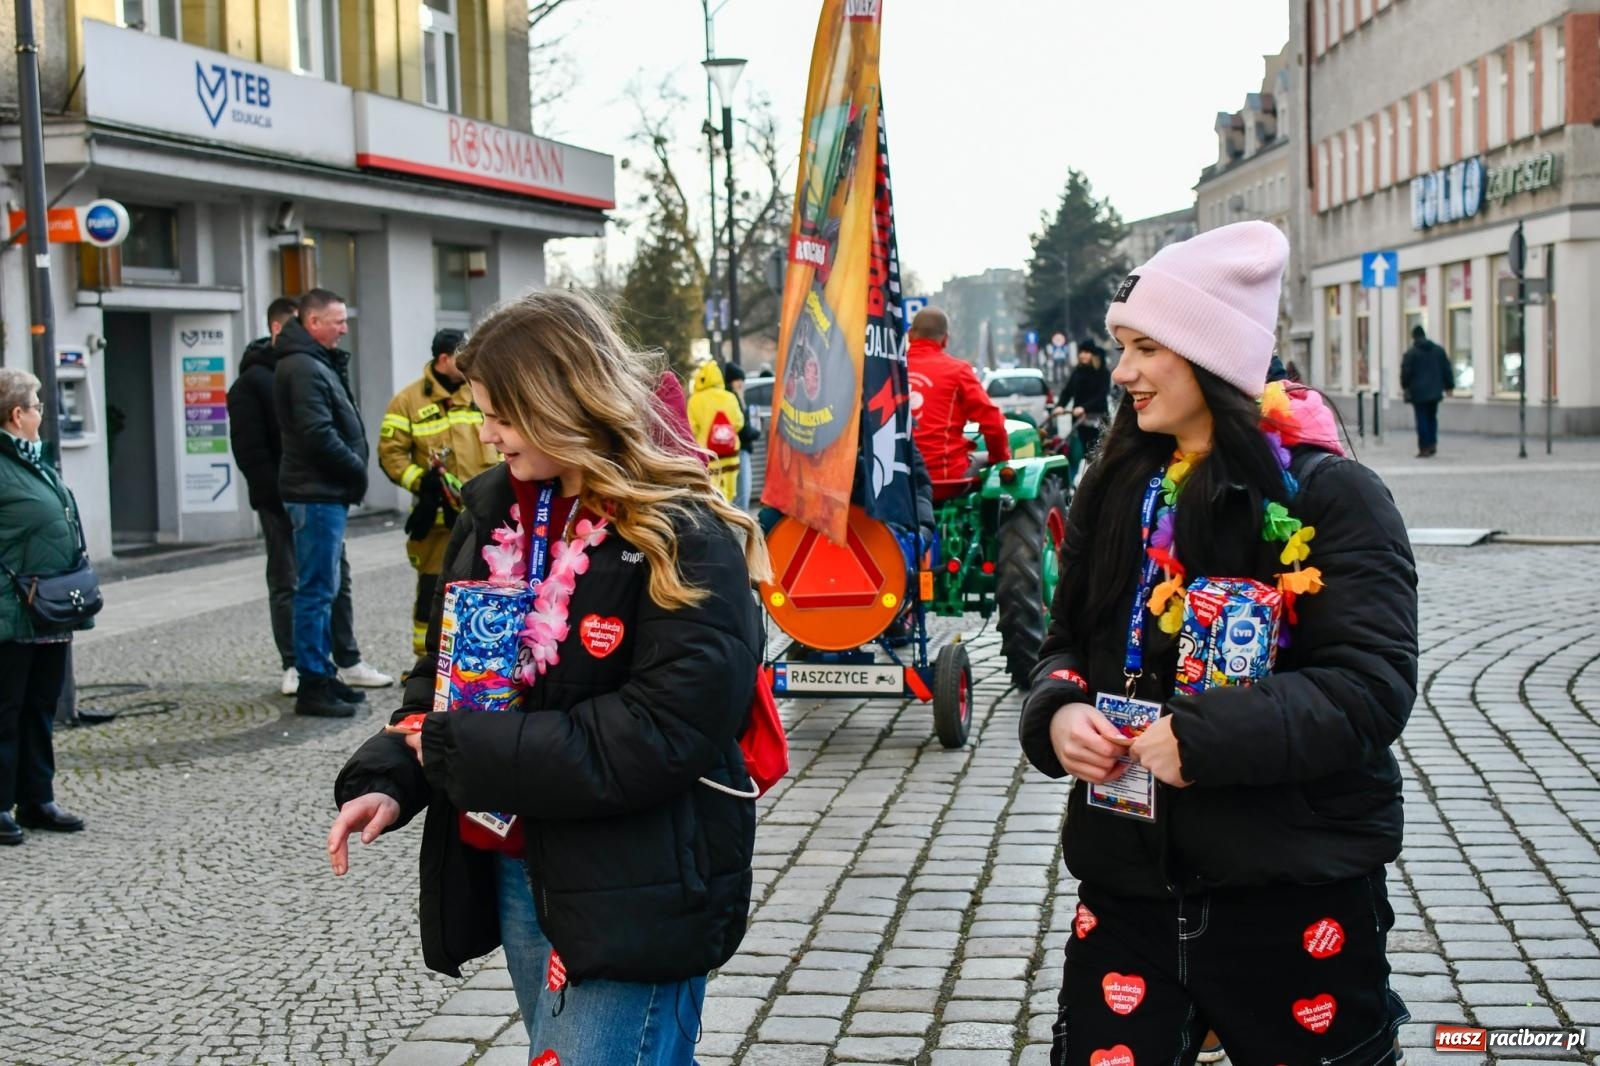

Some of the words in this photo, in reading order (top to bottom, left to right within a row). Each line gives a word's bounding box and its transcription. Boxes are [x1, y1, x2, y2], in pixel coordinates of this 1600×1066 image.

[230, 69, 271, 108] TEB
[448, 117, 564, 184] ROSSMANN
[1410, 157, 1481, 231] BOLKO
[536, 507, 549, 522] 112
[1233, 627, 1252, 637] tvn
[791, 671, 869, 685] RASZCZYCE
[1131, 715, 1149, 727] 33
